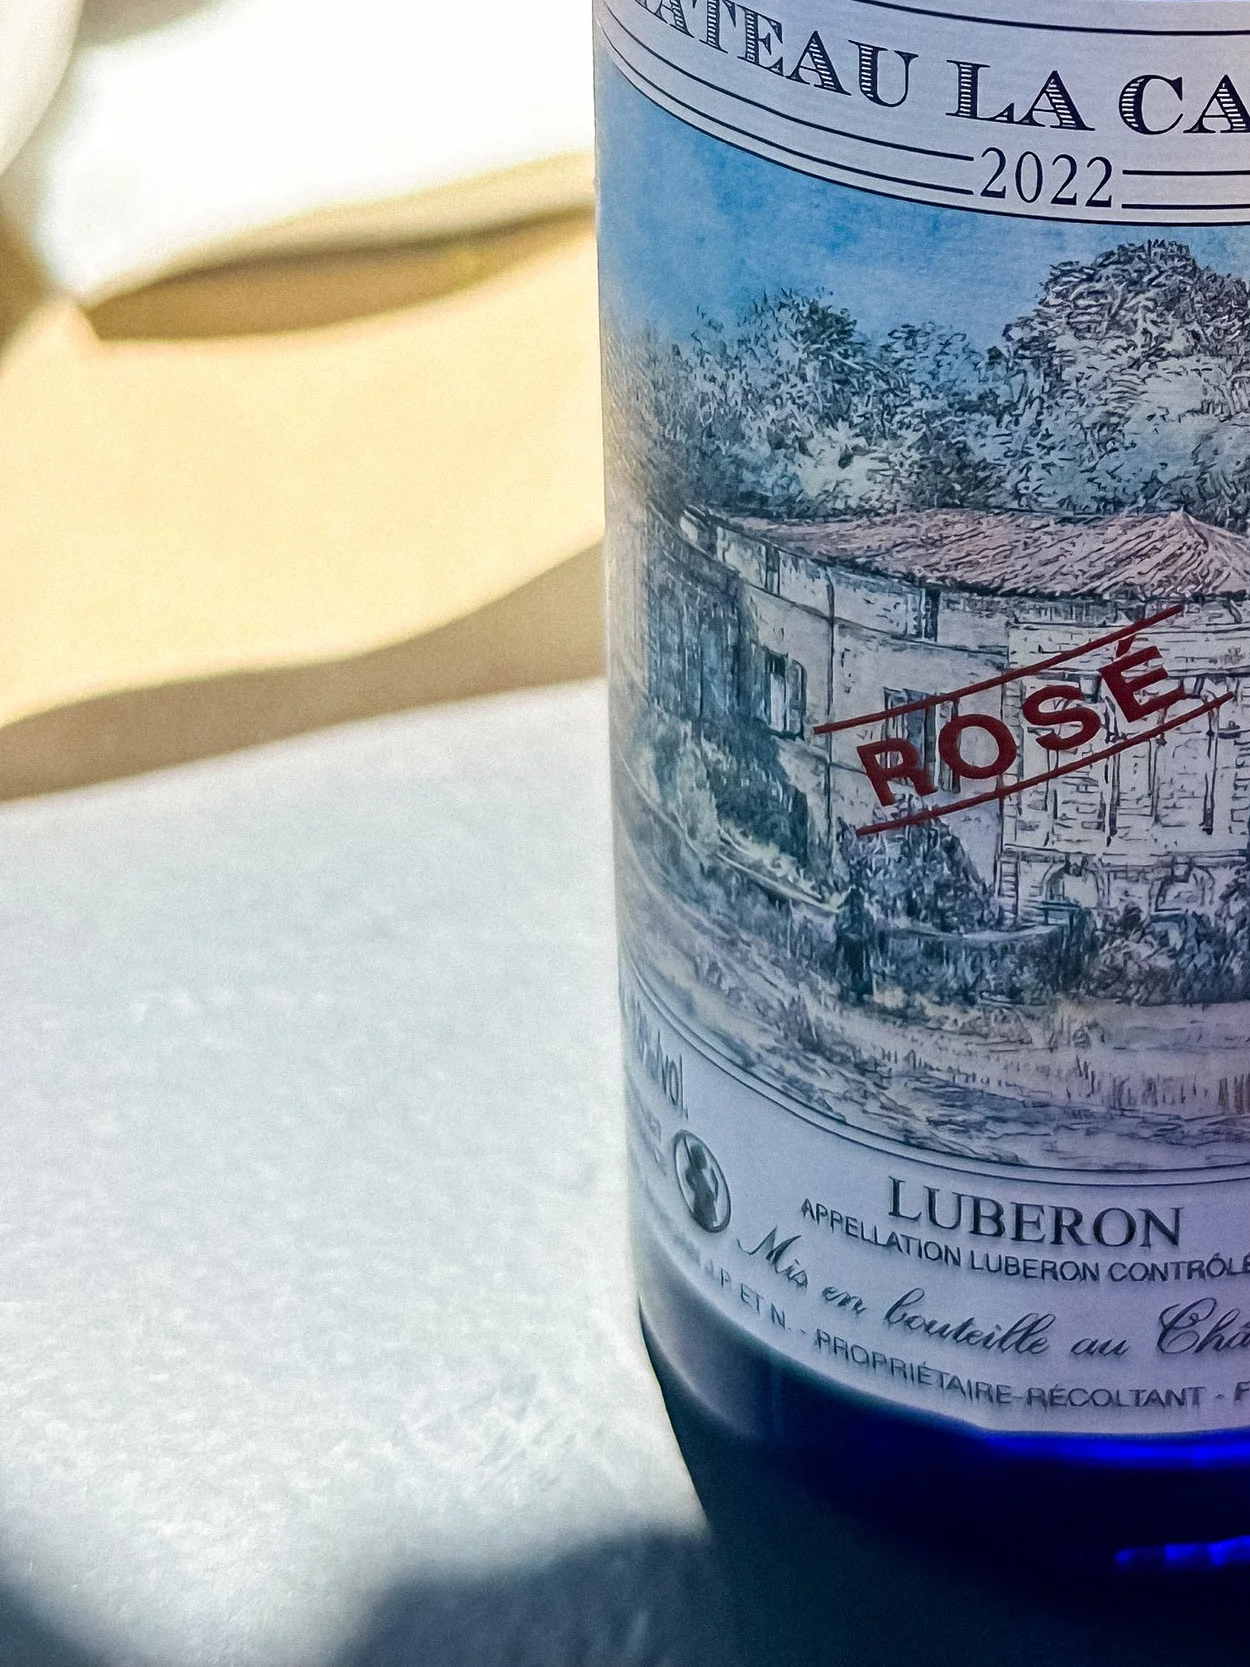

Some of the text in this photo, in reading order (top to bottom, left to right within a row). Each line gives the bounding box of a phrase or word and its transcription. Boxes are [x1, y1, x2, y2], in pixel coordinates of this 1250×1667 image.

[945, 59, 1095, 132] LA
[978, 147, 1114, 208] 2022
[856, 636, 1186, 807] ROSÉ
[801, 1198, 961, 1269] APPELLATION
[970, 1253, 1099, 1283] LUBERON
[888, 1175, 1183, 1250] LUBERON
[736, 1225, 809, 1290] Mis
[821, 1286, 869, 1317] en
[885, 1287, 1057, 1355] bouteille
[1070, 1333, 1131, 1358] au
[740, 1282, 765, 1316] ET
